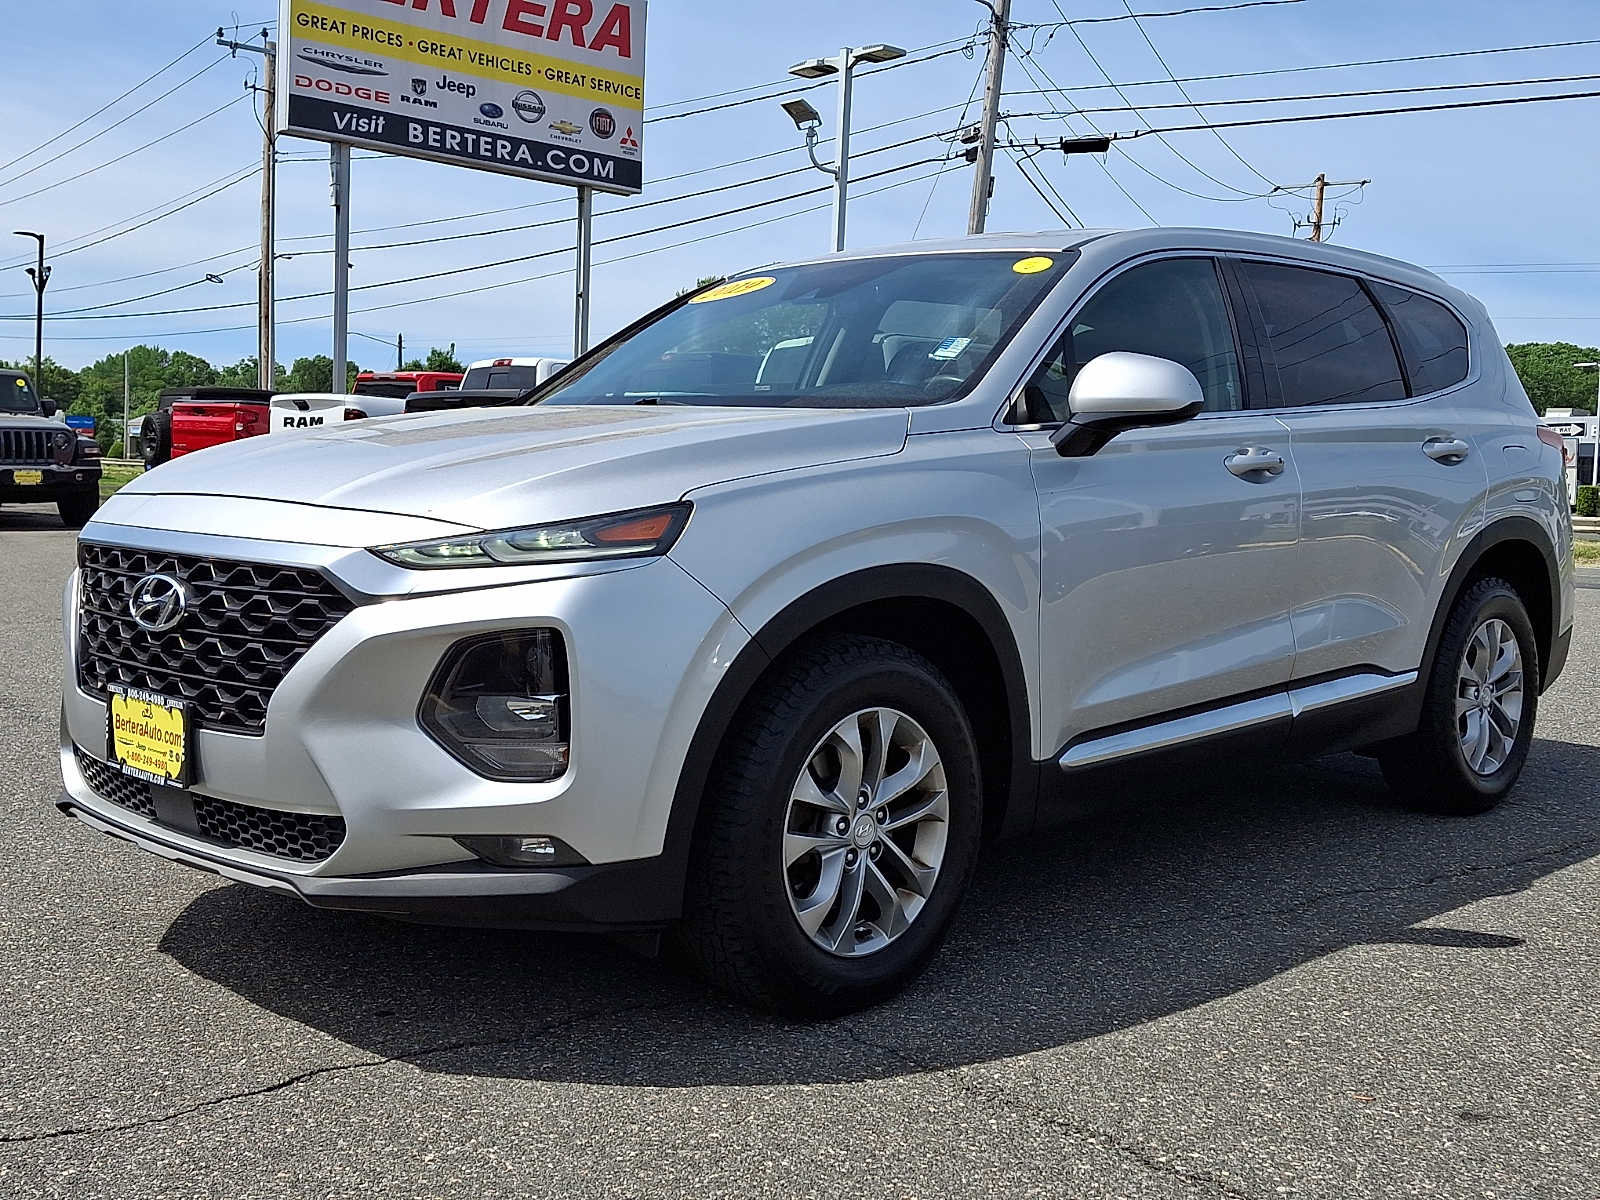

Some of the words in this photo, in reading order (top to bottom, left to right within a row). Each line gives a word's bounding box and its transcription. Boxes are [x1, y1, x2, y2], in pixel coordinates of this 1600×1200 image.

[296, 13, 347, 34] GREAT
[352, 24, 403, 47] PRICES
[417, 40, 463, 60] GREAT
[468, 51, 532, 75] VEHICLES
[545, 68, 586, 87] GREAT
[590, 77, 641, 99] SERVICE
[302, 47, 384, 69] CHRYSLER
[295, 75, 390, 104] DODGE
[436, 75, 476, 98] Jeep
[400, 95, 438, 109] RAM
[515, 101, 543, 112] NISSAN
[473, 118, 509, 129] SUBARU
[333, 112, 386, 133] Visit
[408, 122, 614, 179] BERTERA.COM
[550, 134, 582, 144] CHEVROLET
[283, 416, 324, 428] RAM
[115, 713, 182, 747] BerteraAuto.com
